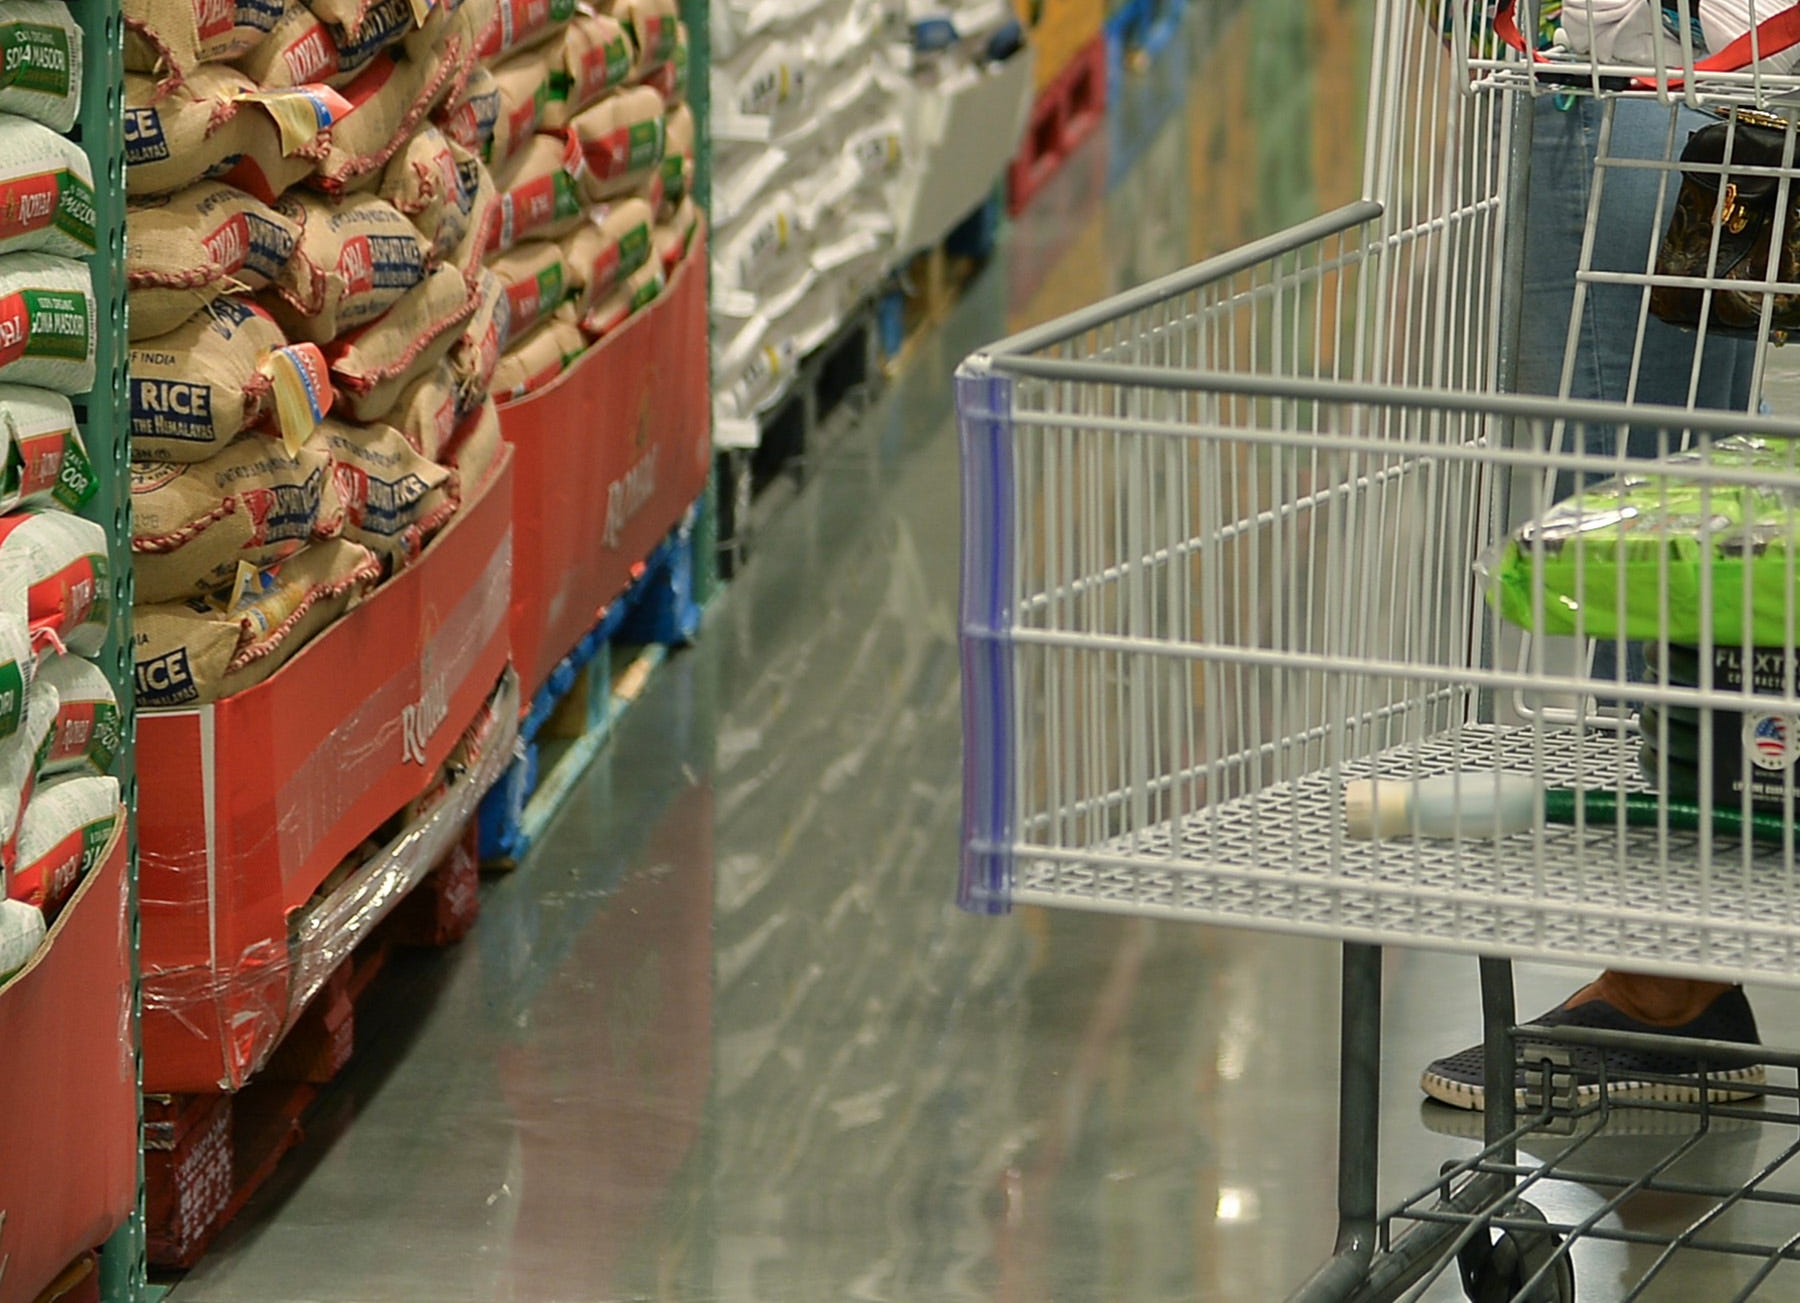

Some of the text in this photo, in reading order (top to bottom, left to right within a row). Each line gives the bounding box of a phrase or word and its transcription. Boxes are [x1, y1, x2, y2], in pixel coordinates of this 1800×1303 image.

[283, 31, 331, 85] ROYAL
[18, 191, 53, 227] ROYAL
[141, 352, 176, 366] INDIA
[140, 381, 209, 417] RICE
[133, 415, 214, 440] THE HIMALAYAS
[136, 651, 188, 695] ICE
[1728, 671, 1789, 689] CORACT
[402, 672, 448, 765] ROYAL
